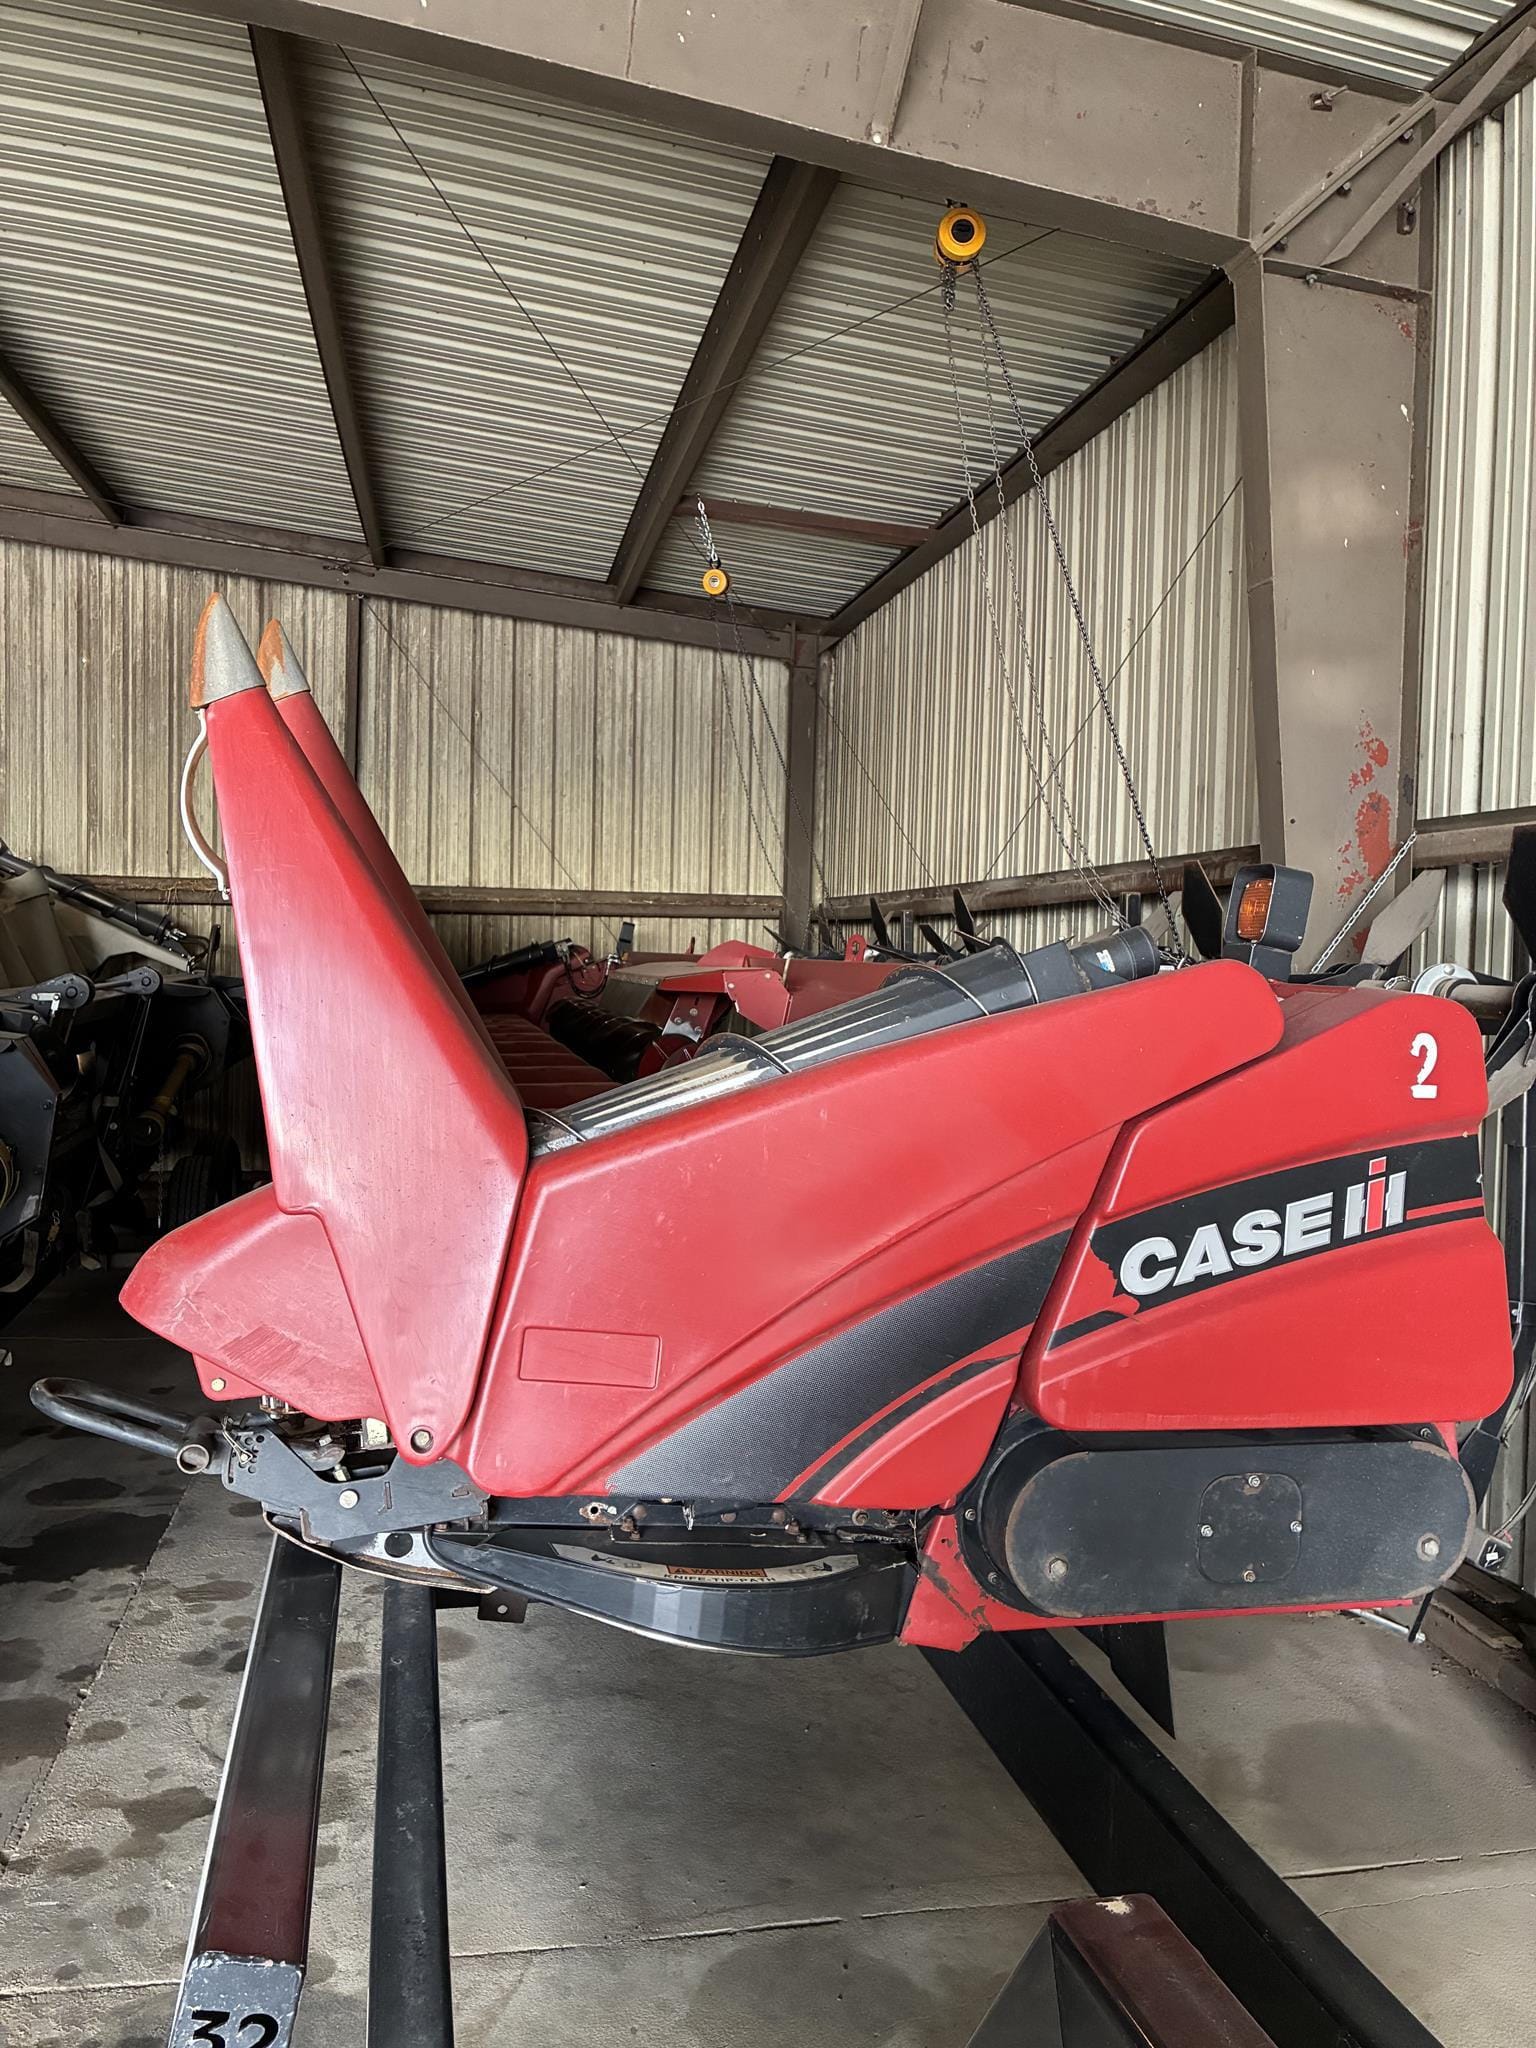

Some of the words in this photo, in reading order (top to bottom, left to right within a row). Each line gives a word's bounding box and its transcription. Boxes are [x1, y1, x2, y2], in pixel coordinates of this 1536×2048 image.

[1411, 1033, 1437, 1098] 2
[1120, 1193, 1333, 1295] CASE
[691, 1568, 759, 1576] WARNING
